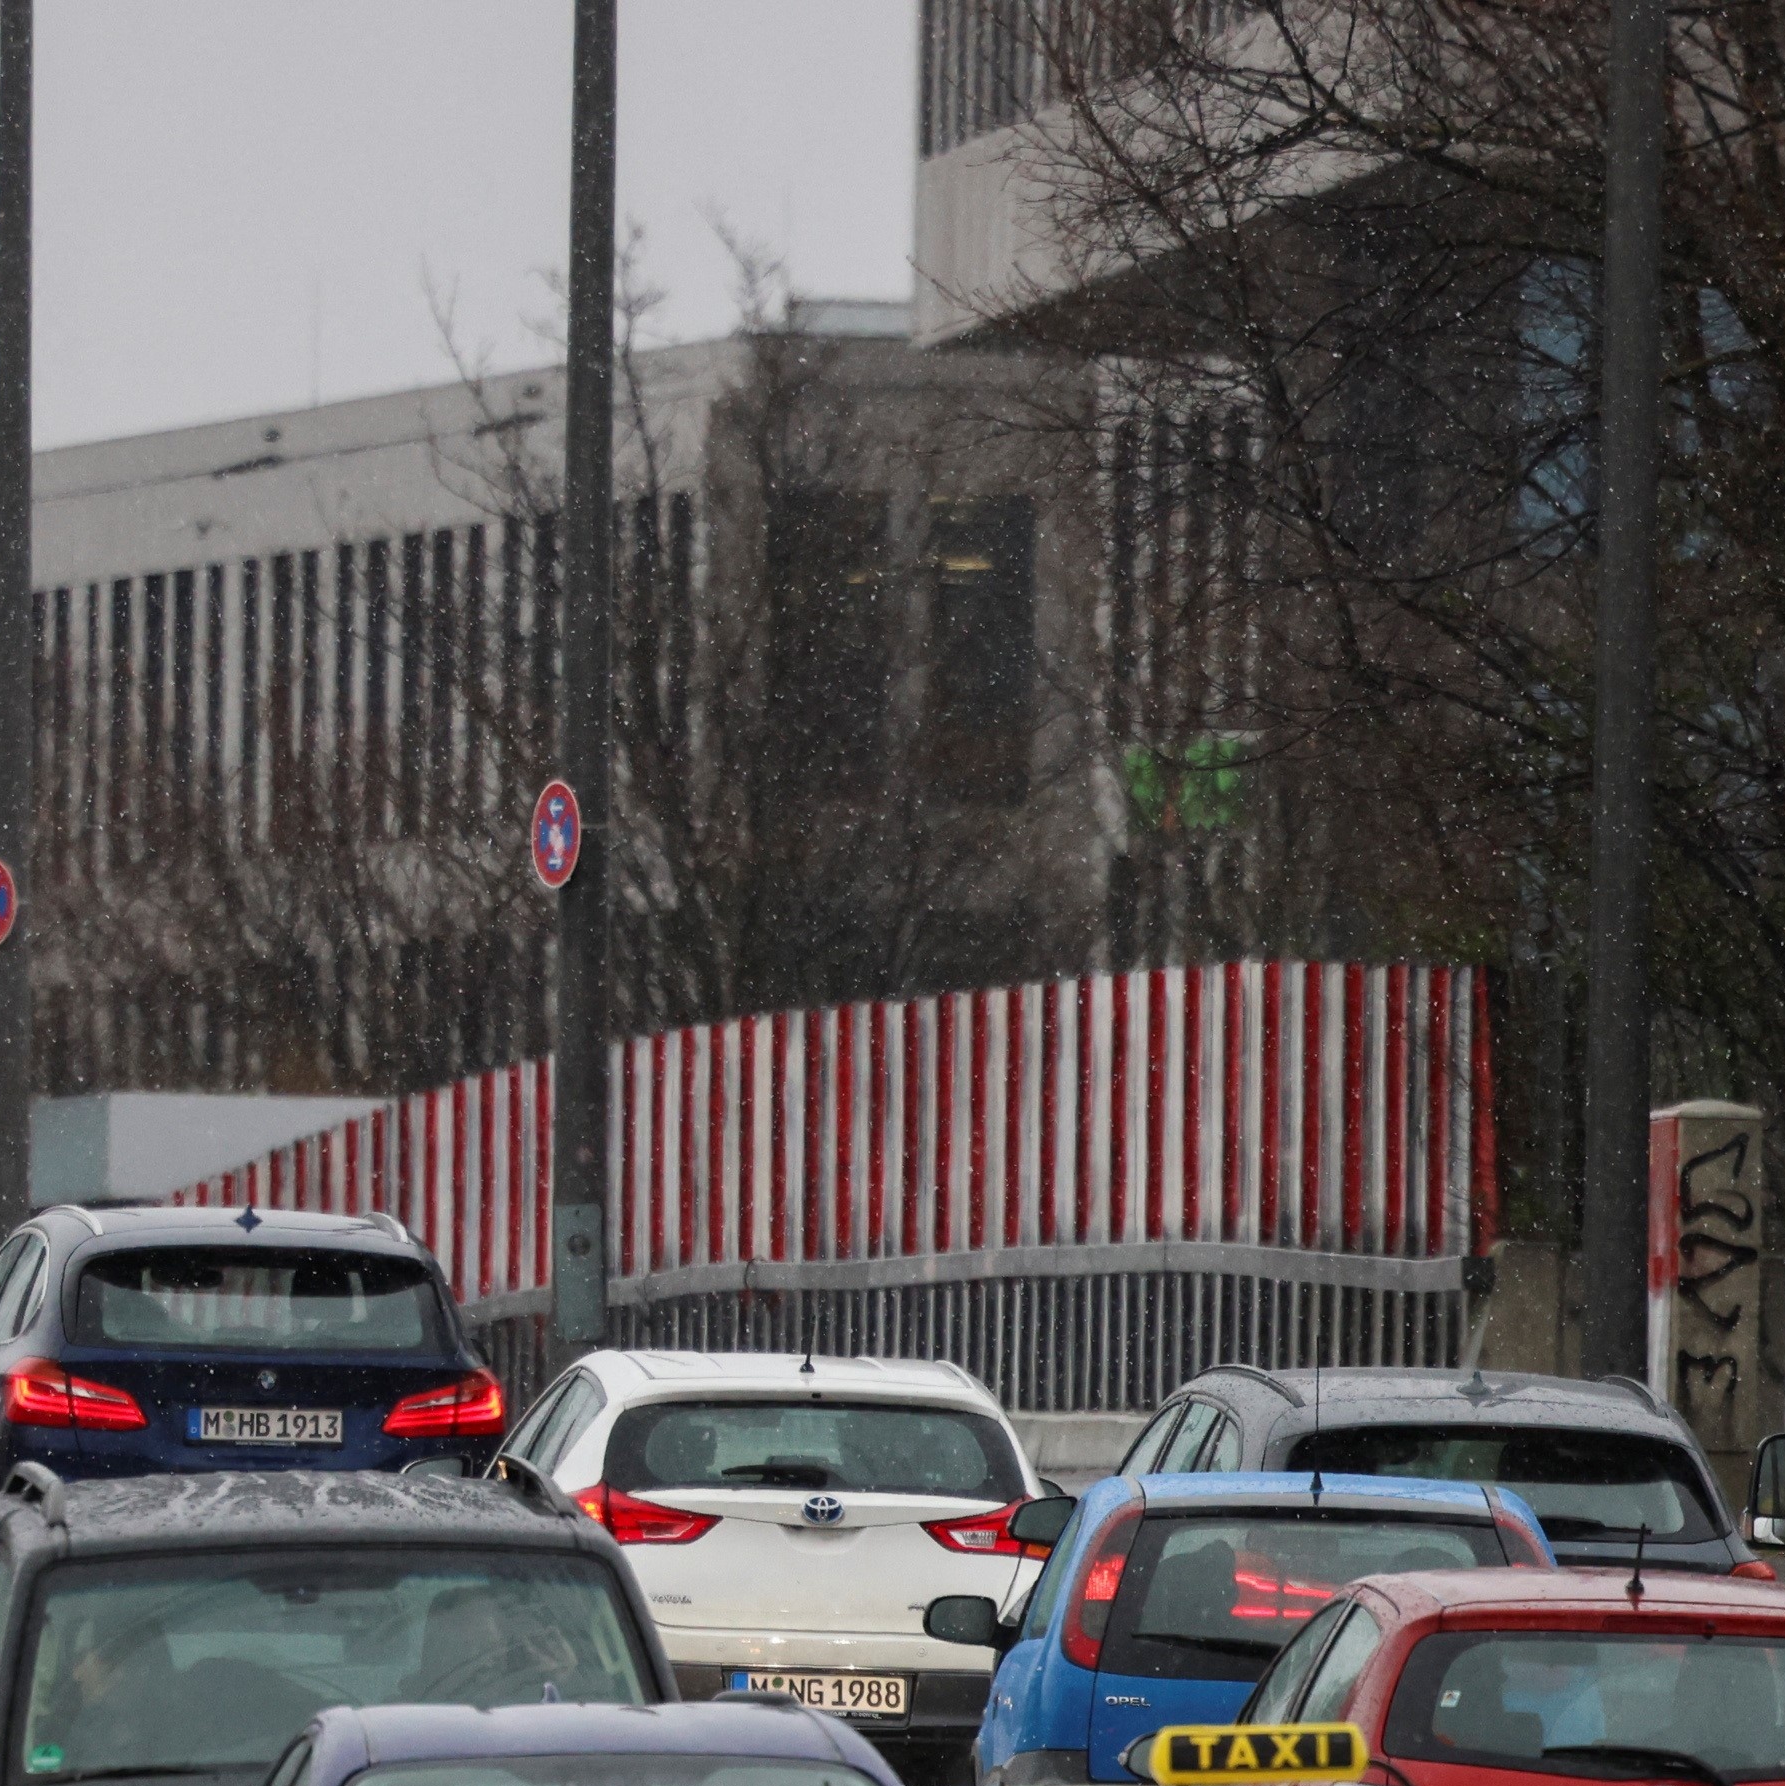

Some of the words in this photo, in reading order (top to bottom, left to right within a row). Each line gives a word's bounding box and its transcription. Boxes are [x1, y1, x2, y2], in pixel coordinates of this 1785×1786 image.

[203, 1411, 221, 1436] M
[237, 1412, 271, 1438] HB
[276, 1413, 339, 1439] 1913
[831, 1678, 901, 1709] 1988
[1105, 1695, 1152, 1707] OPEL
[1188, 1733, 1330, 1771] TAXI
